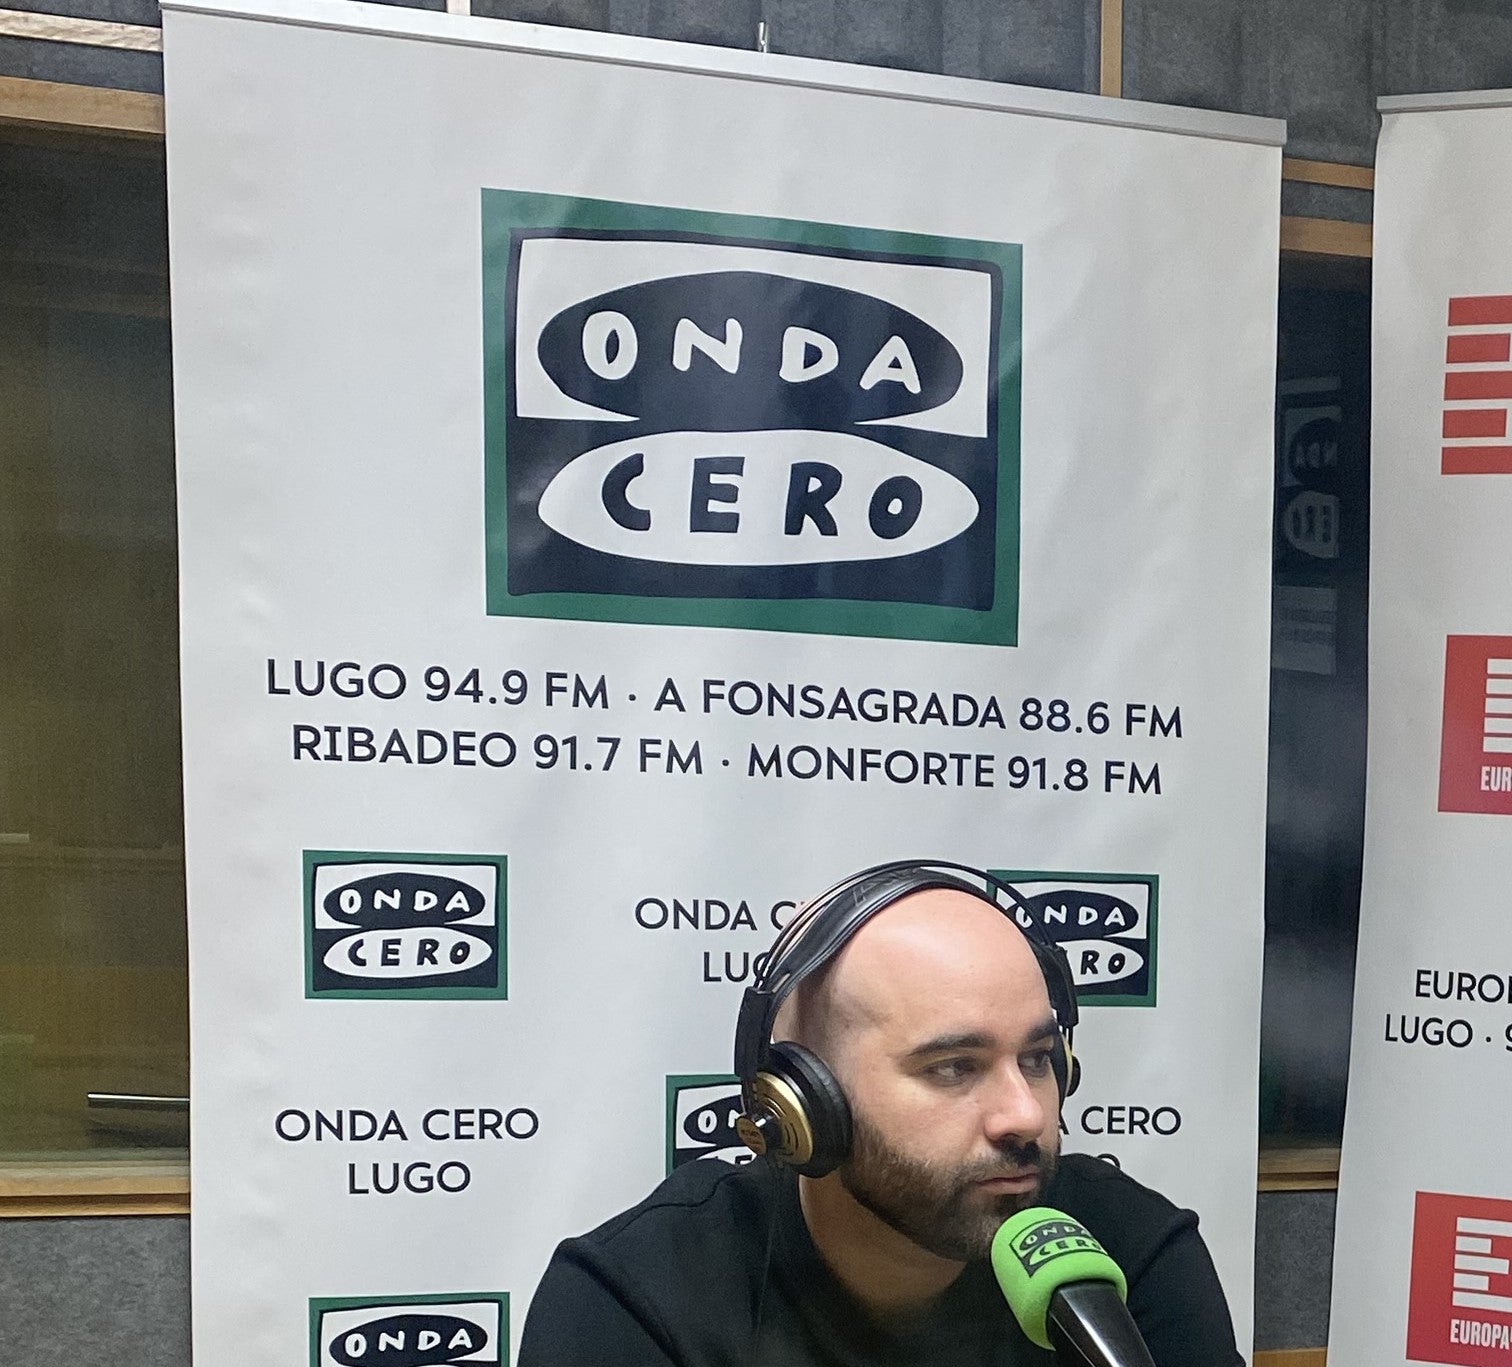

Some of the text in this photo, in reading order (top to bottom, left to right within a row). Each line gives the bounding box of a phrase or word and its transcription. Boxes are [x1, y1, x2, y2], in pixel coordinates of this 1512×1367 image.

[582, 310, 922, 395] ONDA
[600, 452, 923, 540] CERO
[267, 658, 1183, 739] LUGO 94.9 FM A FONSAGRADA 88.6 FM
[293, 724, 1162, 795] RIBADEO 91.7 FM MONFORTE 91.8 FM
[339, 888, 470, 915] ONDA
[634, 897, 758, 931] ONDA
[347, 937, 471, 967] CERO
[1080, 949, 1126, 976] RO
[1384, 1013, 1474, 1048] LUGO
[275, 1107, 539, 1142] ONDA CERO
[1080, 1105, 1182, 1136] CERO
[348, 1161, 471, 1195] LUGO
[344, 1328, 473, 1358] ONDA
